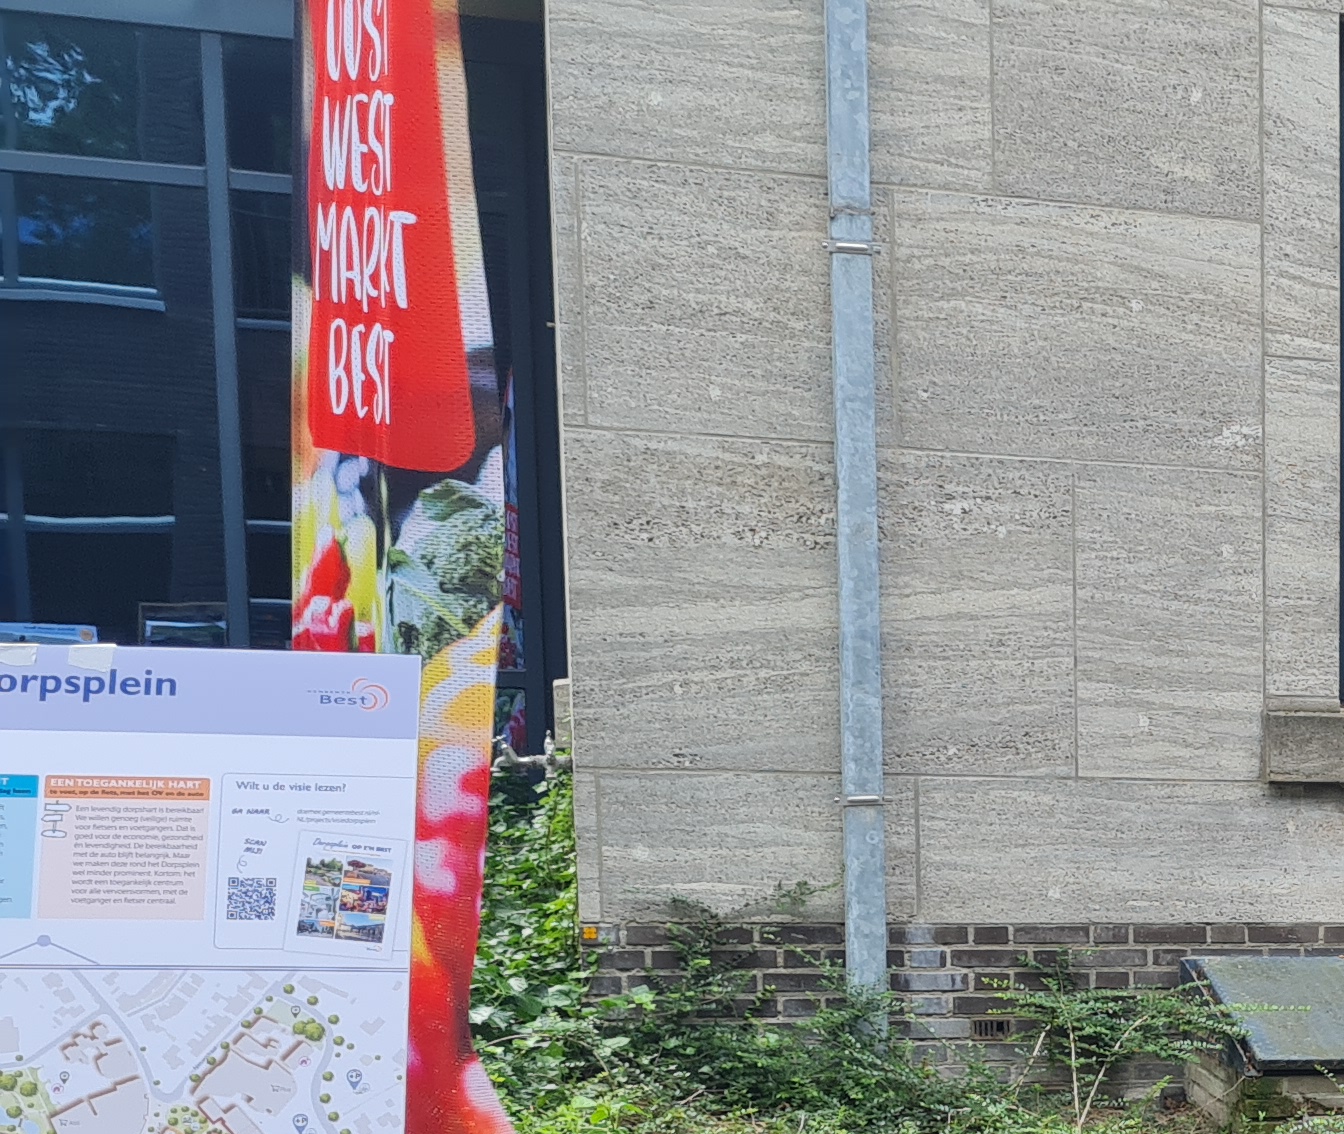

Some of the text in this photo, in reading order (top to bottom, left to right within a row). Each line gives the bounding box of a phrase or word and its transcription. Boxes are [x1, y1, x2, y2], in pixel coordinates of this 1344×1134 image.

[322, 90, 395, 195] WEST
[314, 202, 417, 314] MARKT
[328, 318, 395, 425] BEST
[0, 668, 178, 703] orpsplein
[320, 694, 368, 706] Best
[77, 779, 165, 788] TOEGANKELIJK
[168, 780, 201, 789] HART
[236, 781, 259, 790] Wilt
[273, 781, 285, 791] de
[289, 782, 311, 792] visie
[315, 783, 347, 792] lezen?
